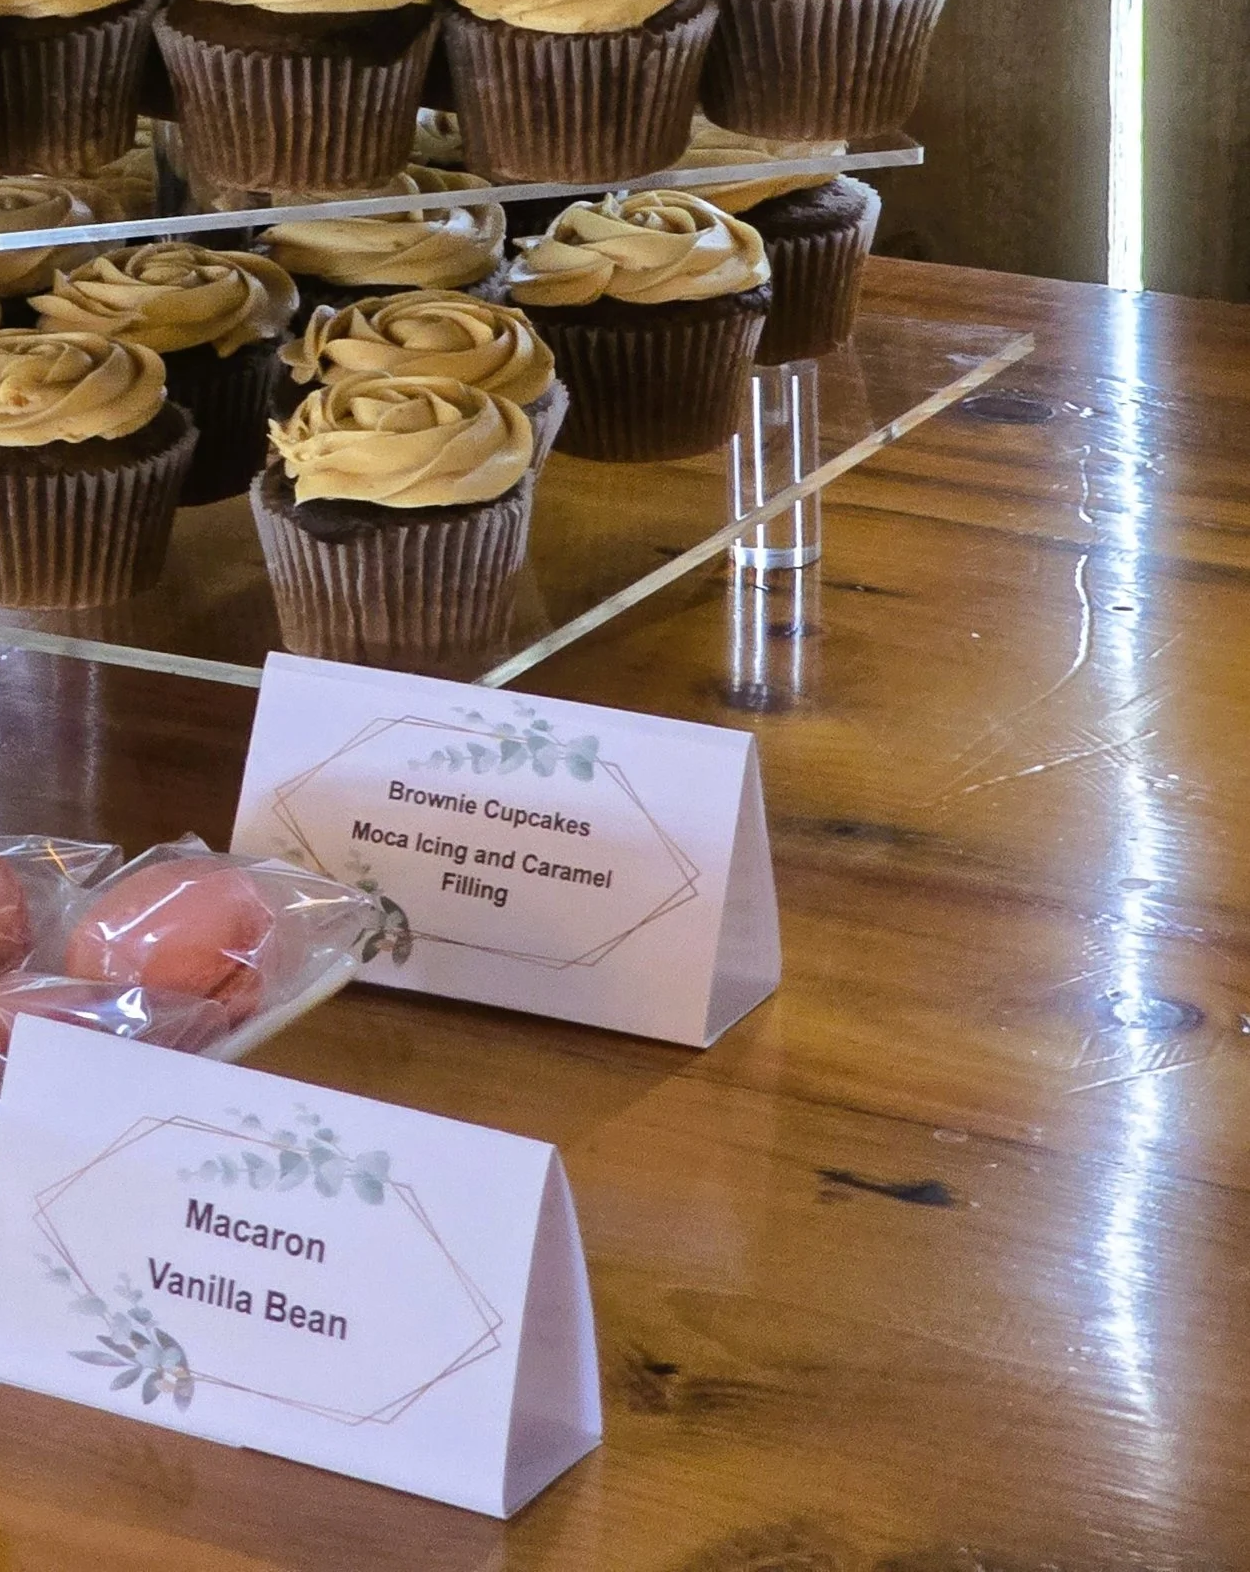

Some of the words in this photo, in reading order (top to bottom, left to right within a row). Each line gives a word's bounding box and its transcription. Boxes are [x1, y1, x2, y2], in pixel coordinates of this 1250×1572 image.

[388, 780, 478, 815] Brownie
[484, 799, 591, 838] Cupcakes
[351, 820, 409, 849] Moca
[415, 831, 470, 865] Icing
[474, 848, 515, 870] and
[521, 854, 613, 889] Caramel
[441, 872, 509, 907] Filling
[185, 1198, 326, 1263] Macaron
[148, 1258, 253, 1314] Vanilla
[264, 1289, 349, 1341] Bean
